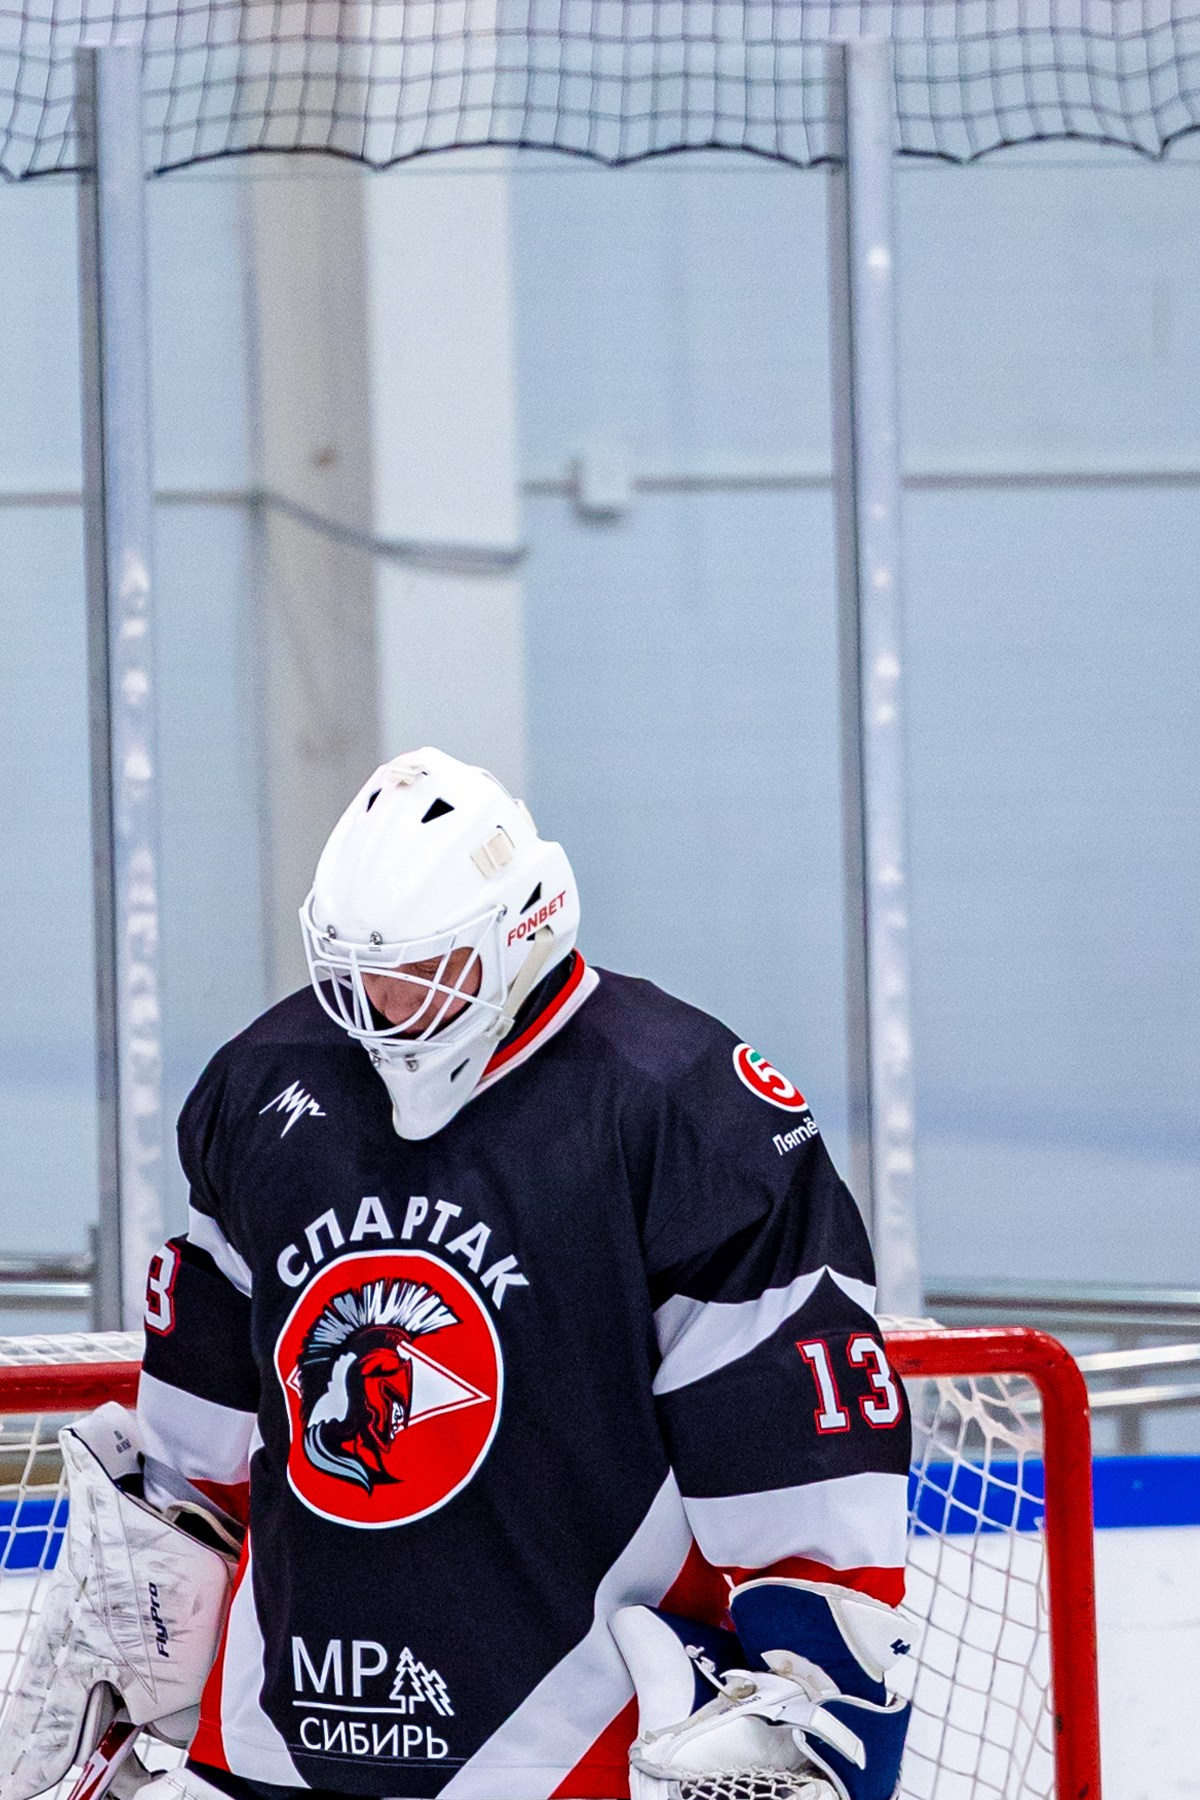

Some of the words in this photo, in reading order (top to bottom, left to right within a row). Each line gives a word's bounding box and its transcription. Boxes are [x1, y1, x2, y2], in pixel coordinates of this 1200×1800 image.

[507, 890, 566, 947] FONBET
[277, 1196, 530, 1310] СПАРТАК
[796, 1332, 903, 1435] 13
[300, 1717, 449, 1759] СИБИРЬ
